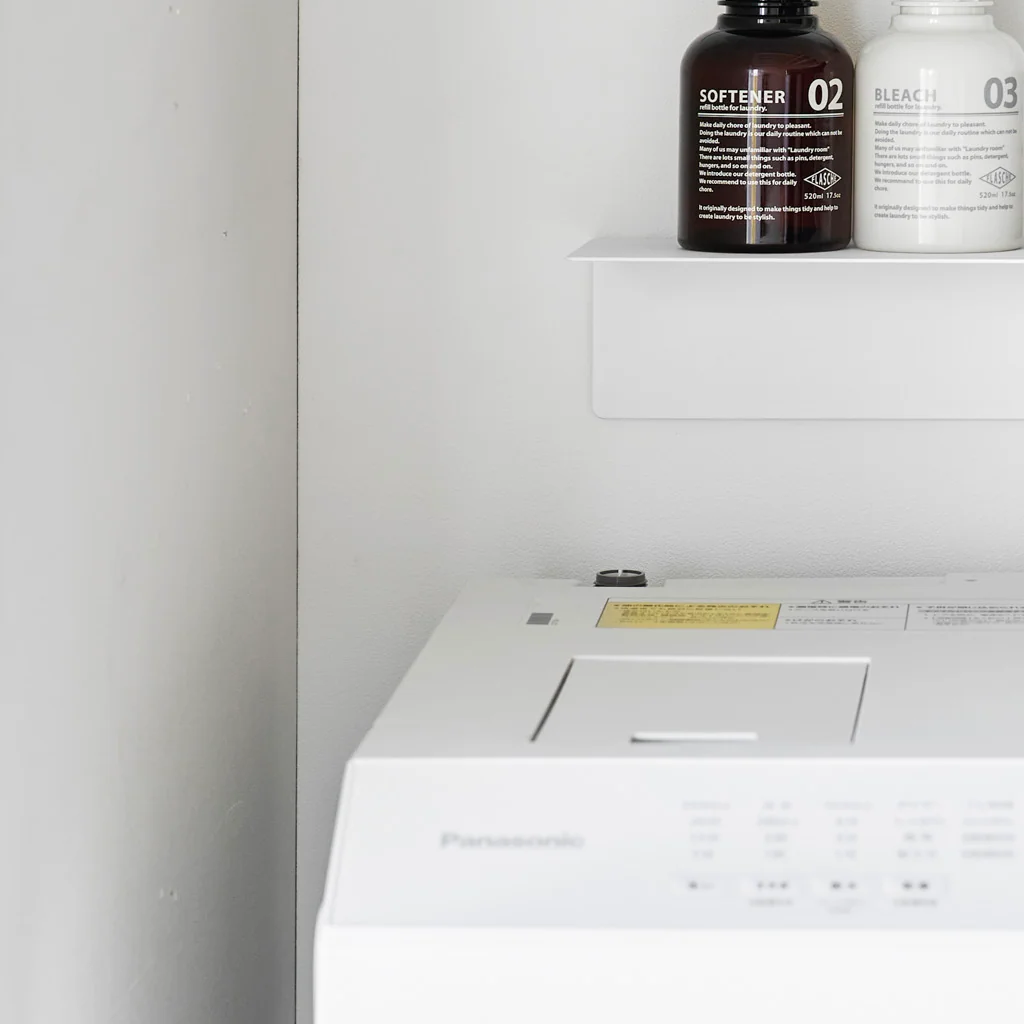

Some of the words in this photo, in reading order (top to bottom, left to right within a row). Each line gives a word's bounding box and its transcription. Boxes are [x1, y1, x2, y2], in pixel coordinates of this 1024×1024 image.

[699, 89, 786, 103] SOFTENER
[808, 78, 843, 111] 02
[875, 88, 937, 102] BLEACH
[983, 76, 1018, 110] 03
[700, 103, 710, 111] refill
[729, 104, 740, 112] for
[740, 104, 768, 113] laundry.
[712, 121, 726, 129] daily
[752, 122, 777, 130] laundry
[785, 122, 811, 130] pleasant.
[699, 129, 714, 137] Doing
[765, 130, 782, 138] daily
[750, 154, 771, 163] things
[795, 154, 809, 163] pins,
[782, 178, 798, 187] daily
[804, 192, 824, 200] 520ml
[703, 204, 727, 212] originally
[727, 205, 756, 213] designed
[801, 205, 813, 213] tidy
[713, 213, 736, 221] laundry
[753, 213, 776, 221] stylish.
